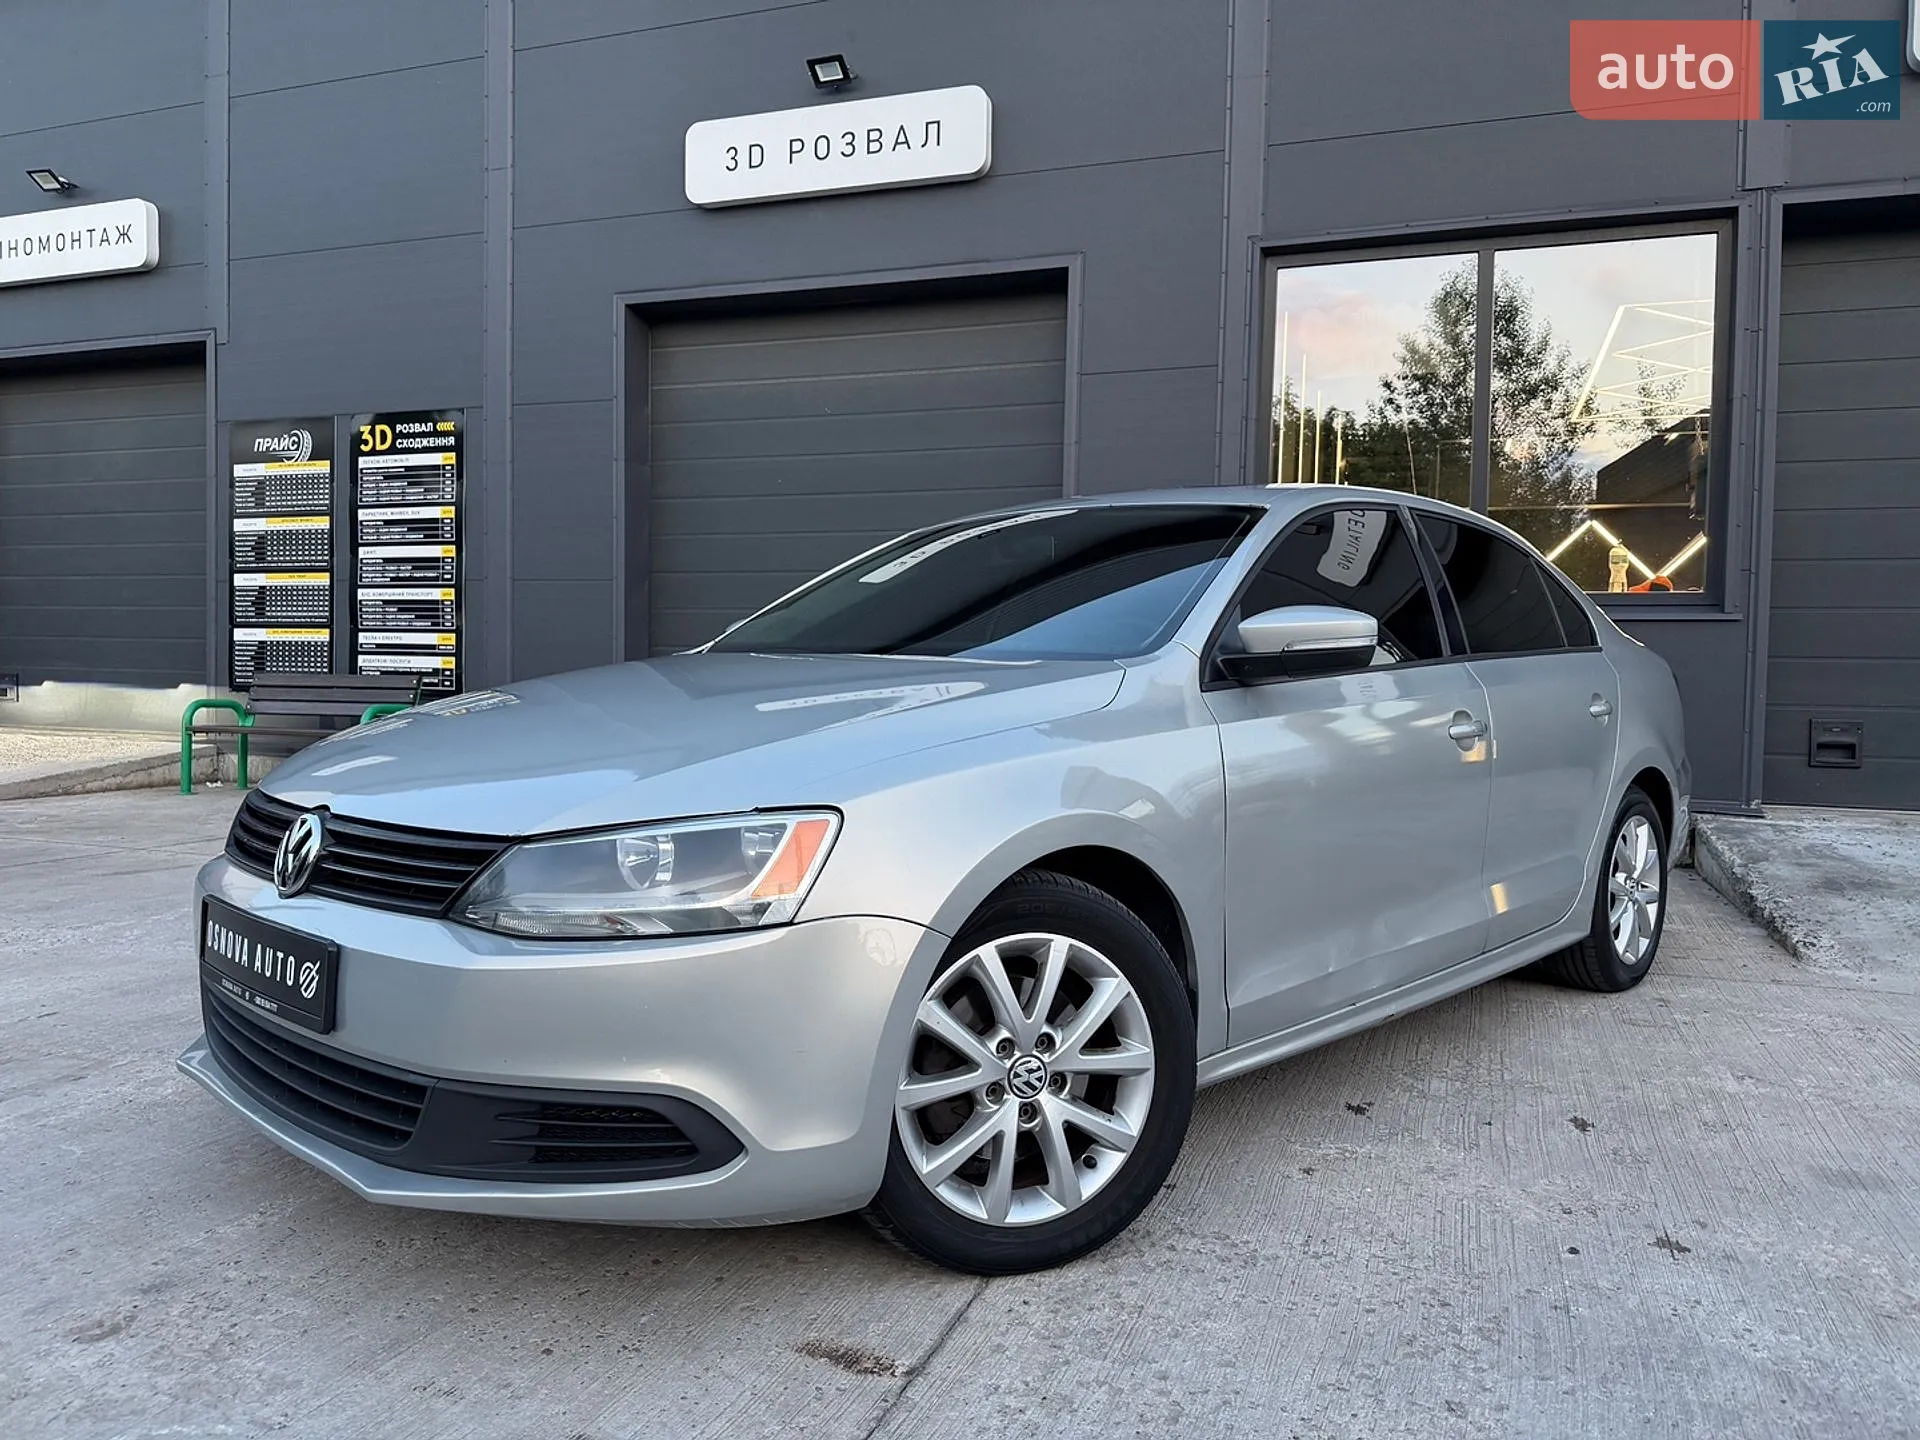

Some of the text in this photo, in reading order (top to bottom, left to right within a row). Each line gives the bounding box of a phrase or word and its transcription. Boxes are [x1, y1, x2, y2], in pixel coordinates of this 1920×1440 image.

[725, 119, 942, 172] 3D РОЗВАЛ
[0, 223, 133, 259] НОМОНТАЖ
[254, 434, 299, 452] ПРАЙС
[359, 422, 434, 453] 3D РОЗВАЛ
[395, 436, 455, 449] СХОДЖЕННЯ
[207, 919, 295, 987] OSNOVA AUTO
